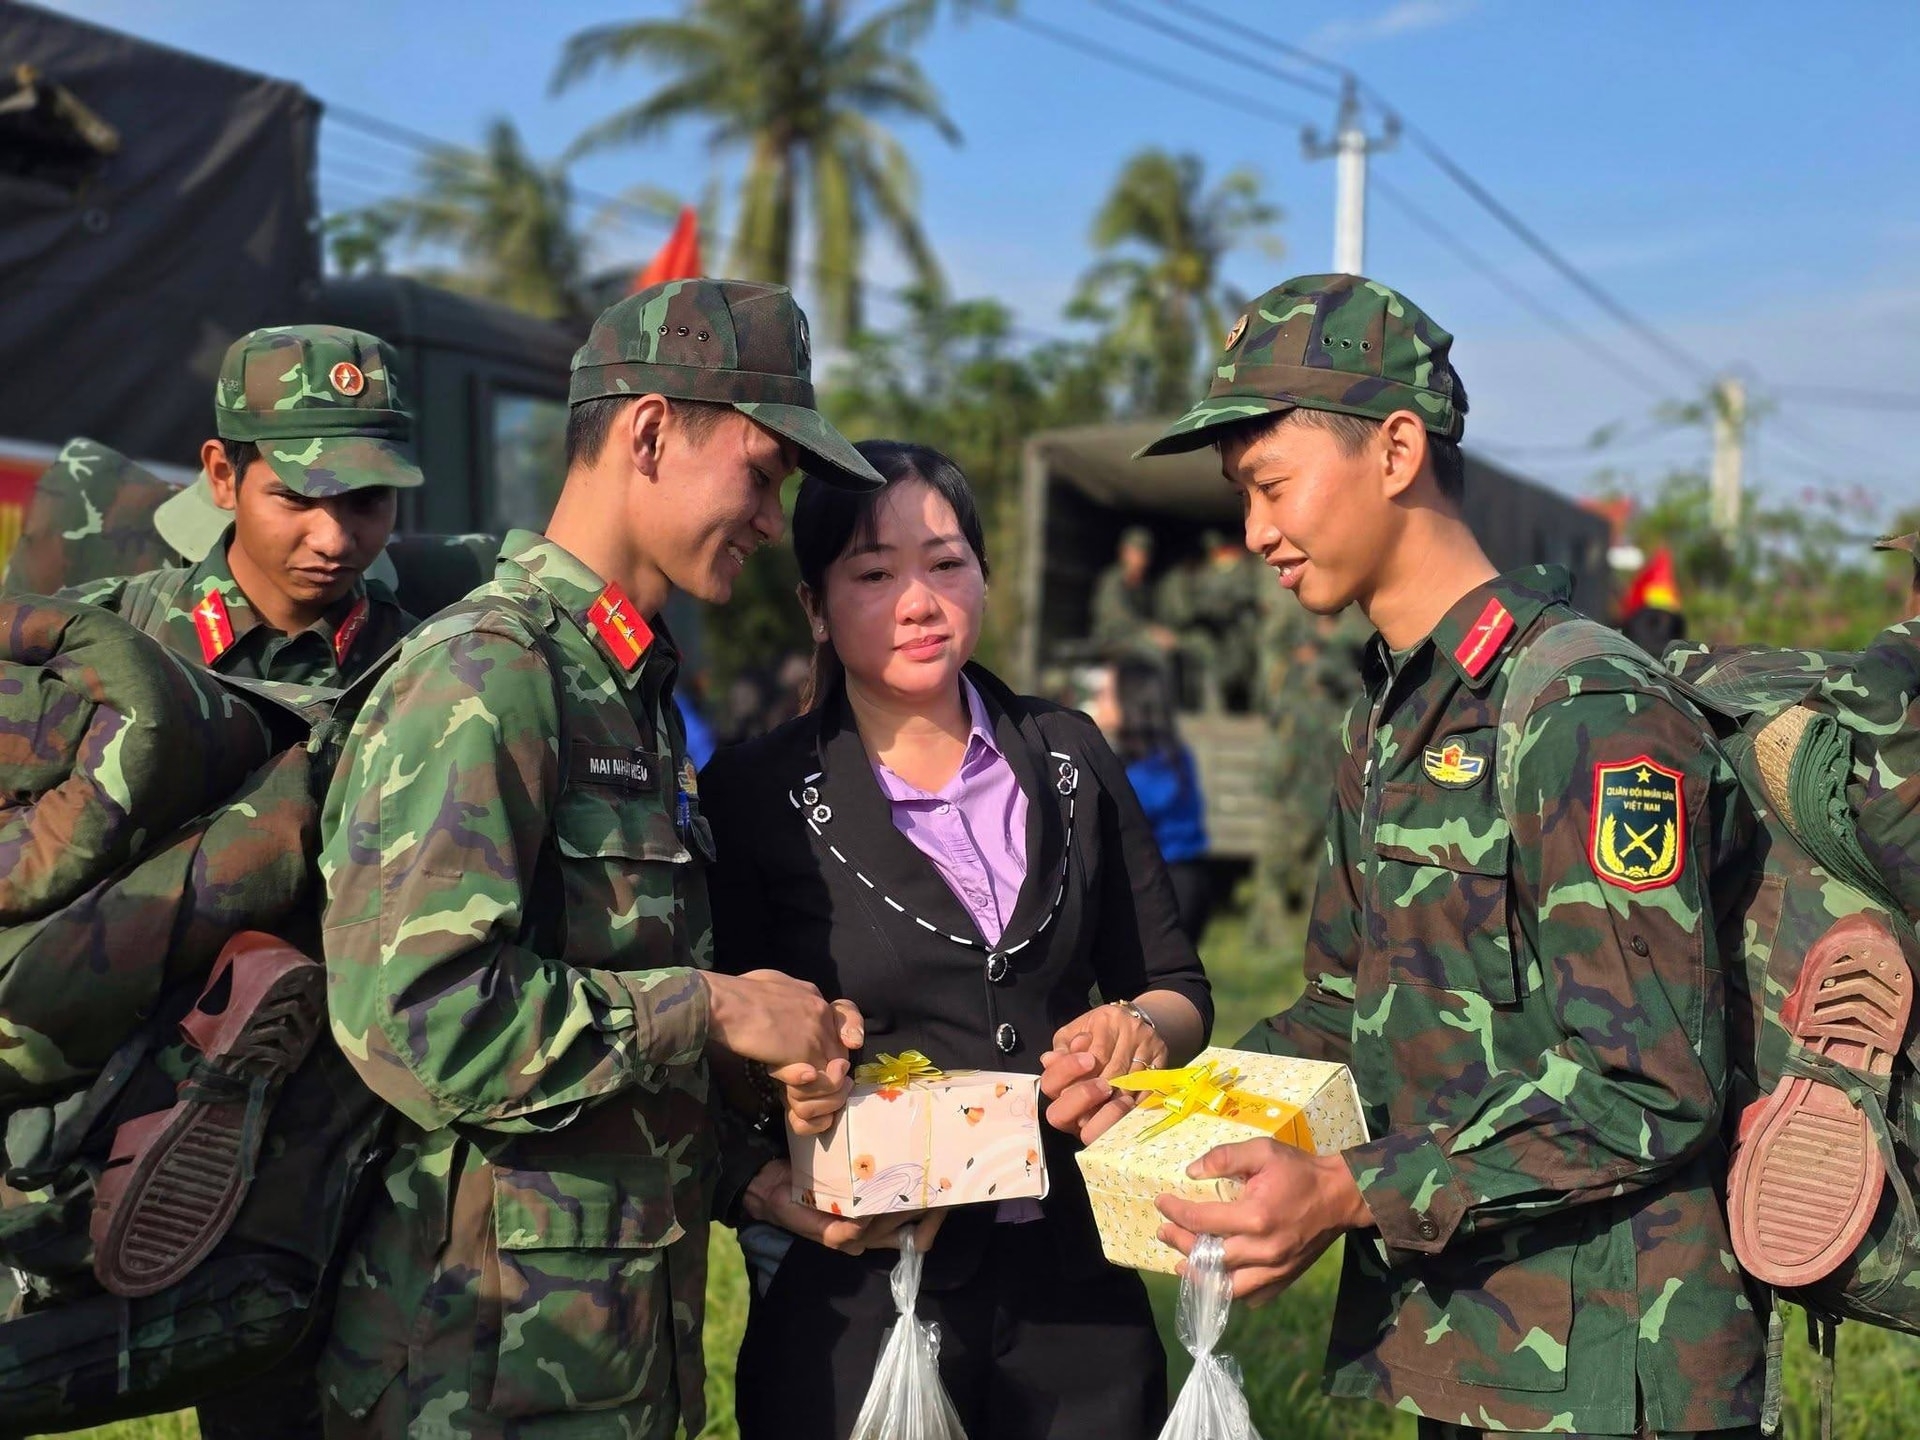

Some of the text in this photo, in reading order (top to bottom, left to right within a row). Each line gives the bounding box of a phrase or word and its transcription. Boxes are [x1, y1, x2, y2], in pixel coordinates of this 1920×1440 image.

[589, 757, 611, 774] MAI
[1606, 786, 1675, 801] QUÂN ĐỘI NHÂN DÂN
[1623, 800, 1661, 812] VIỆT NAM
